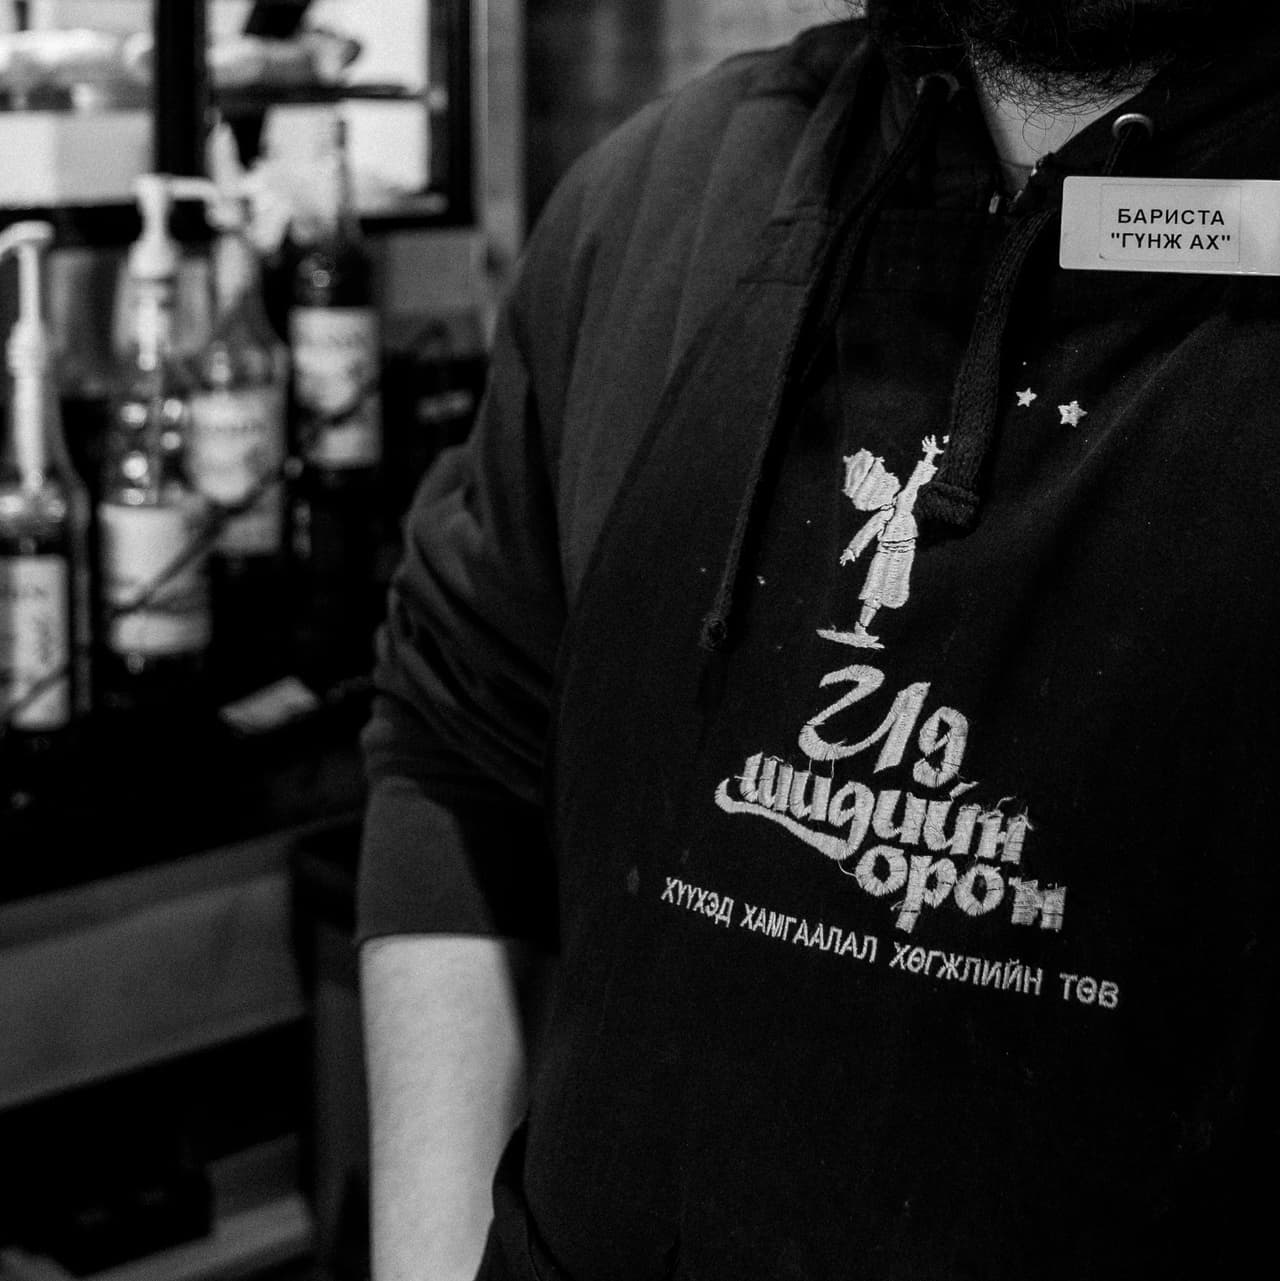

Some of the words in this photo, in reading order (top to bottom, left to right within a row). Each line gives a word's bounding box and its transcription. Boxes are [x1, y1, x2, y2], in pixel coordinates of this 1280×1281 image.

[1117, 208, 1225, 225] БАРИСТА
[1189, 234, 1231, 250] АХ"
[660, 876, 735, 928] ХҮҮХЭД
[739, 902, 878, 963] ХАМГААЛАЛ
[888, 940, 1043, 996] ХӨГЖЛИЙН
[1058, 972, 1120, 1009] ТӨВ
